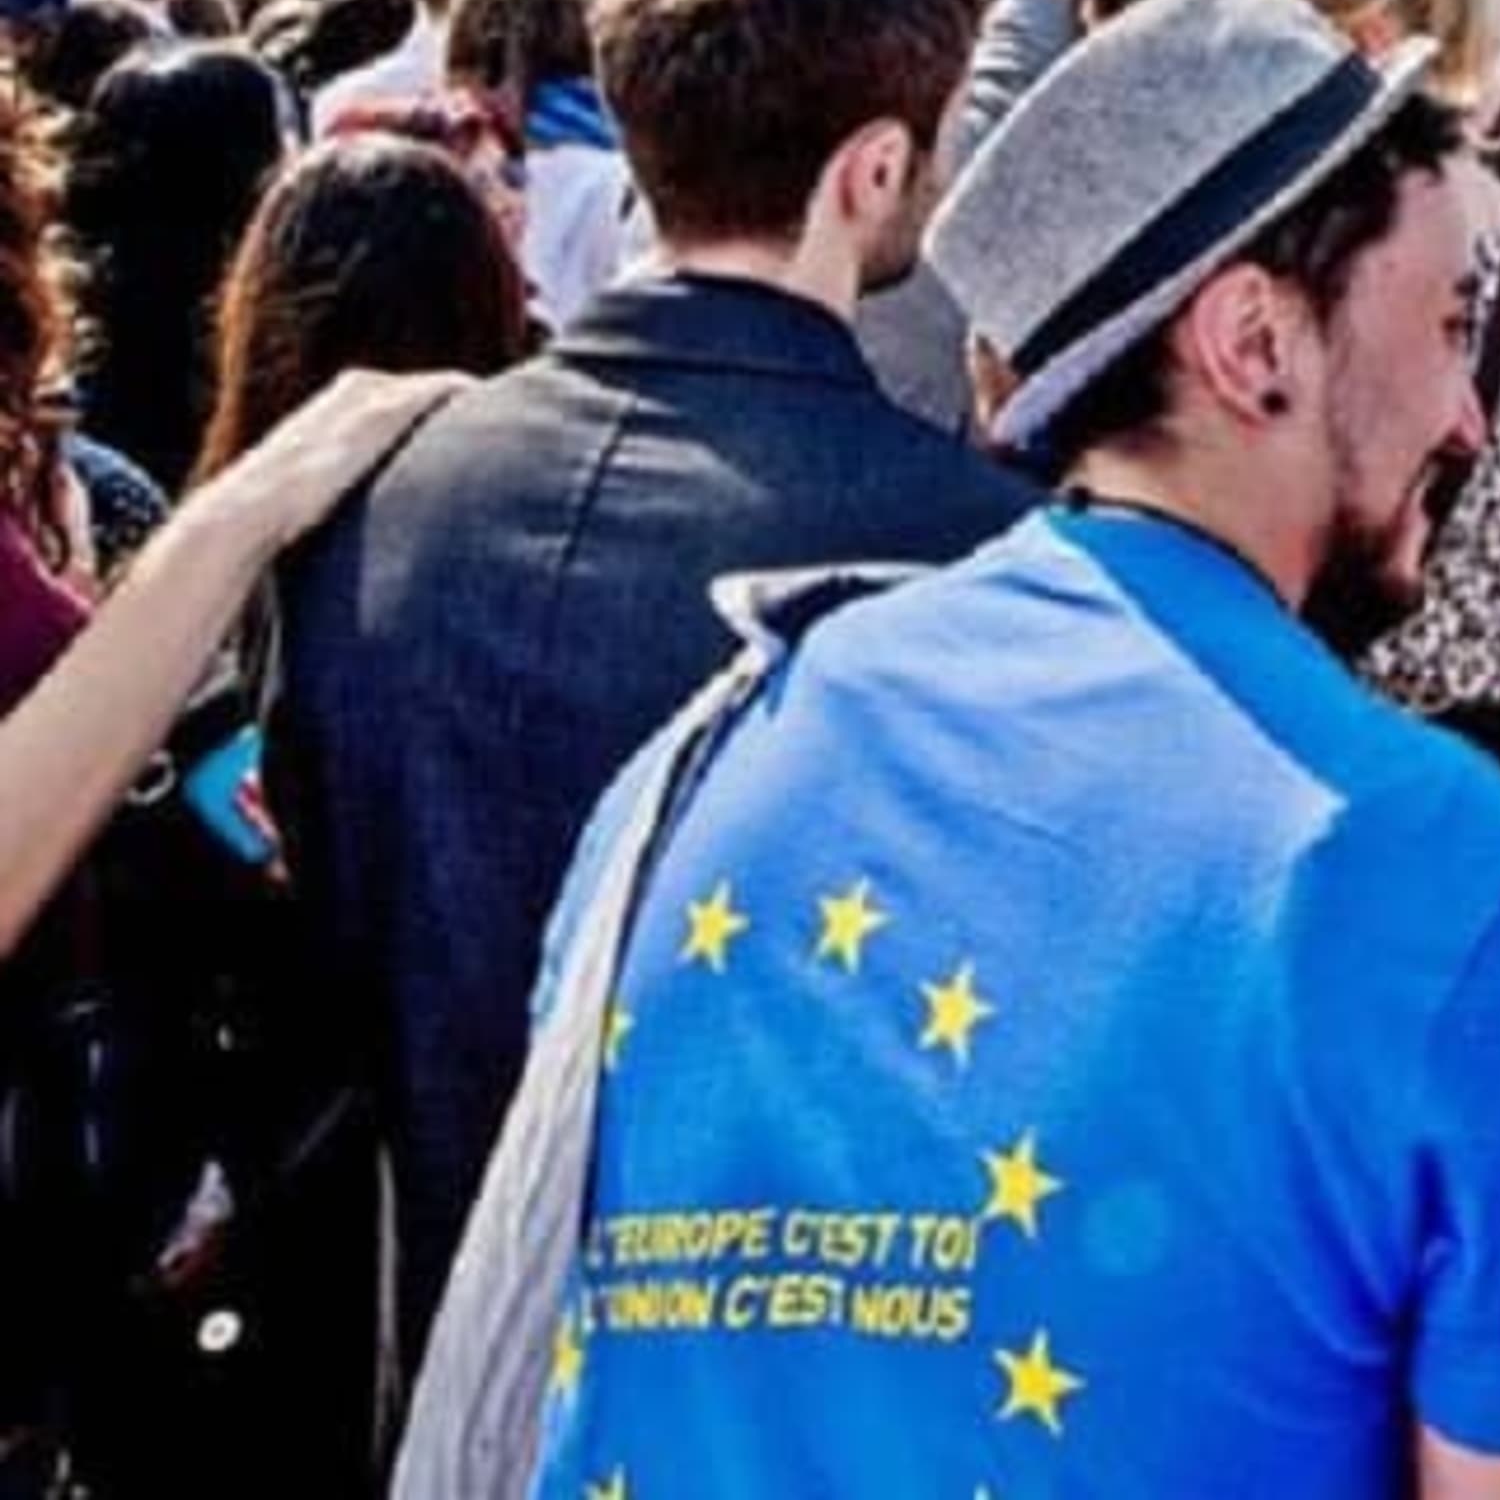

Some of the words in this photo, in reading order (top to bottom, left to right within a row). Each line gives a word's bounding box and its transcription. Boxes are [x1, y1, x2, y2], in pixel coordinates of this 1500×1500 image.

[588, 1206, 779, 1269] L'EUROPE
[782, 1206, 901, 1269] C'EST
[909, 1212, 981, 1272] TOI
[723, 1272, 846, 1329] C'EST
[850, 1285, 973, 1343] NOUS
